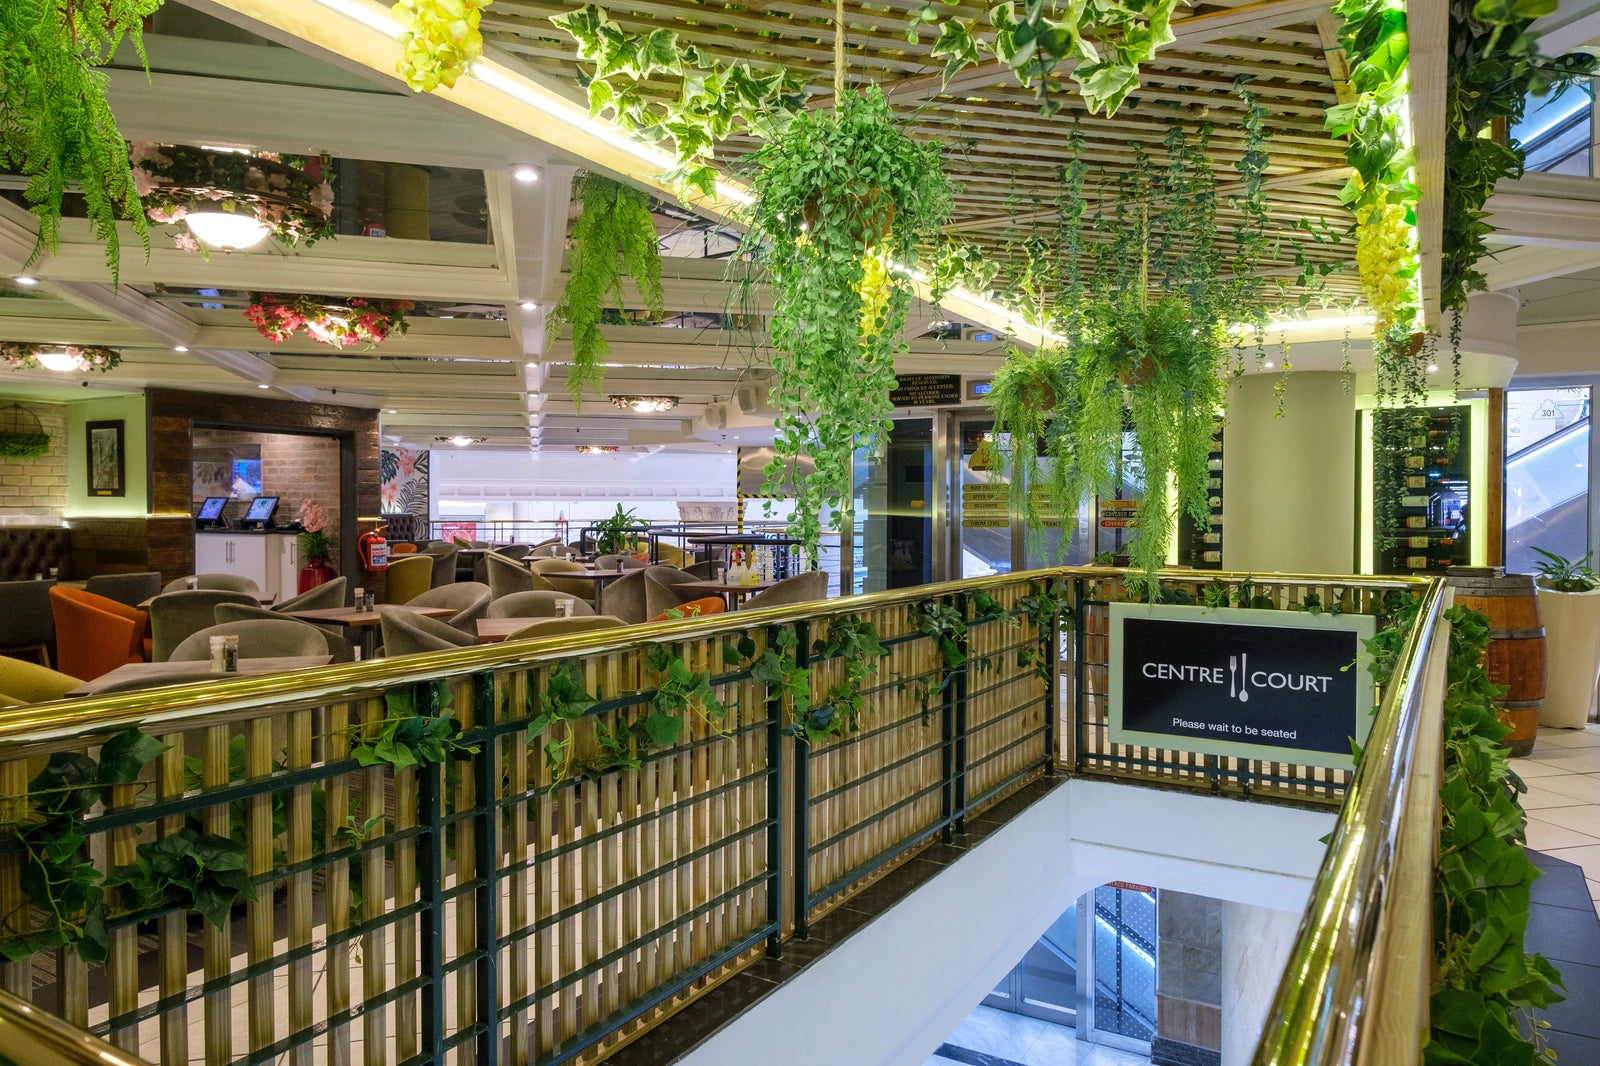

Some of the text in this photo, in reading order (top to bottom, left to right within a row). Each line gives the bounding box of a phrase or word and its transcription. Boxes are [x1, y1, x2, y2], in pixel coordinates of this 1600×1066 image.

[1541, 409, 1555, 417] 301
[1142, 662, 1333, 693] CENTRE COURT
[1172, 717, 1297, 740] Please wait to be seated
